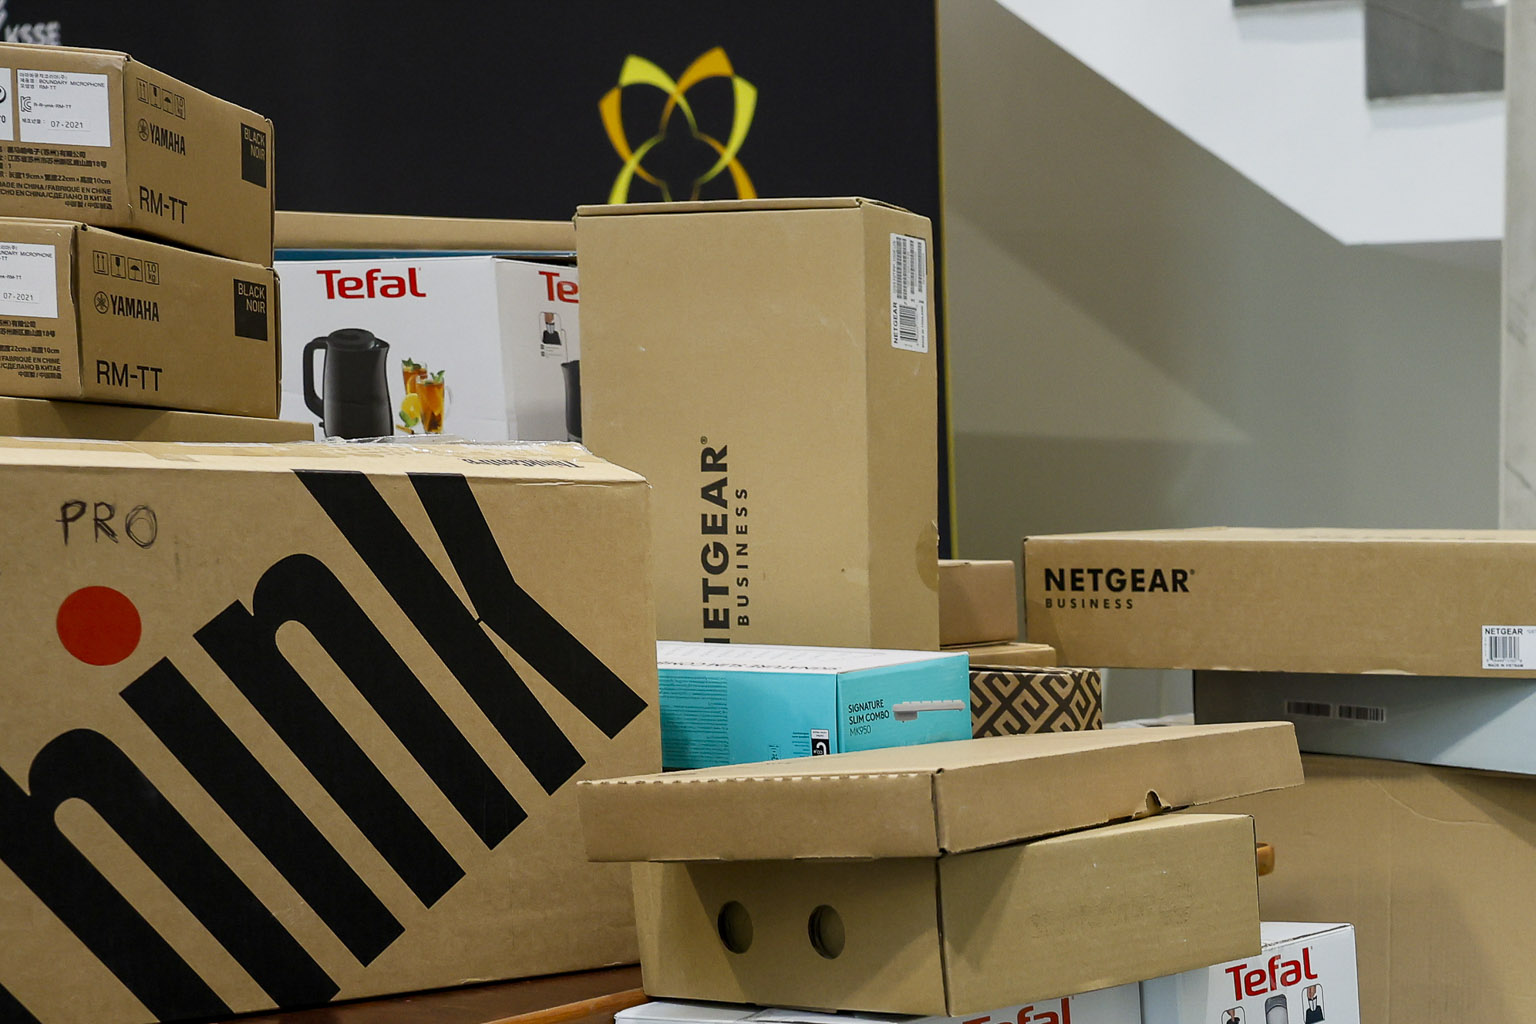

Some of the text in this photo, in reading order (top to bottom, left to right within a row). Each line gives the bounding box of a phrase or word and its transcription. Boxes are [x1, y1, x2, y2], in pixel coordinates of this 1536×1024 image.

[150, 124, 185, 156] YAMAHA
[244, 127, 265, 147] BLACK
[250, 144, 265, 159] NOIR
[139, 185, 187, 224] RM-TT
[238, 283, 265, 299] BLACK
[316, 267, 427, 300] Tefal
[111, 294, 160, 322] YAMAHA
[246, 299, 265, 314] NOIR
[97, 360, 162, 391] RM-TT
[56, 500, 159, 549] PRO
[736, 488, 749, 626] BUSINESS
[1044, 567, 1189, 594] NETGEAR
[1045, 598, 1134, 609] BUSINESS
[848, 699, 885, 714] SIGNATURE
[849, 710, 890, 725] SLIM COMBO
[850, 725, 872, 736] MK950
[1225, 947, 1317, 1001] Tefal
